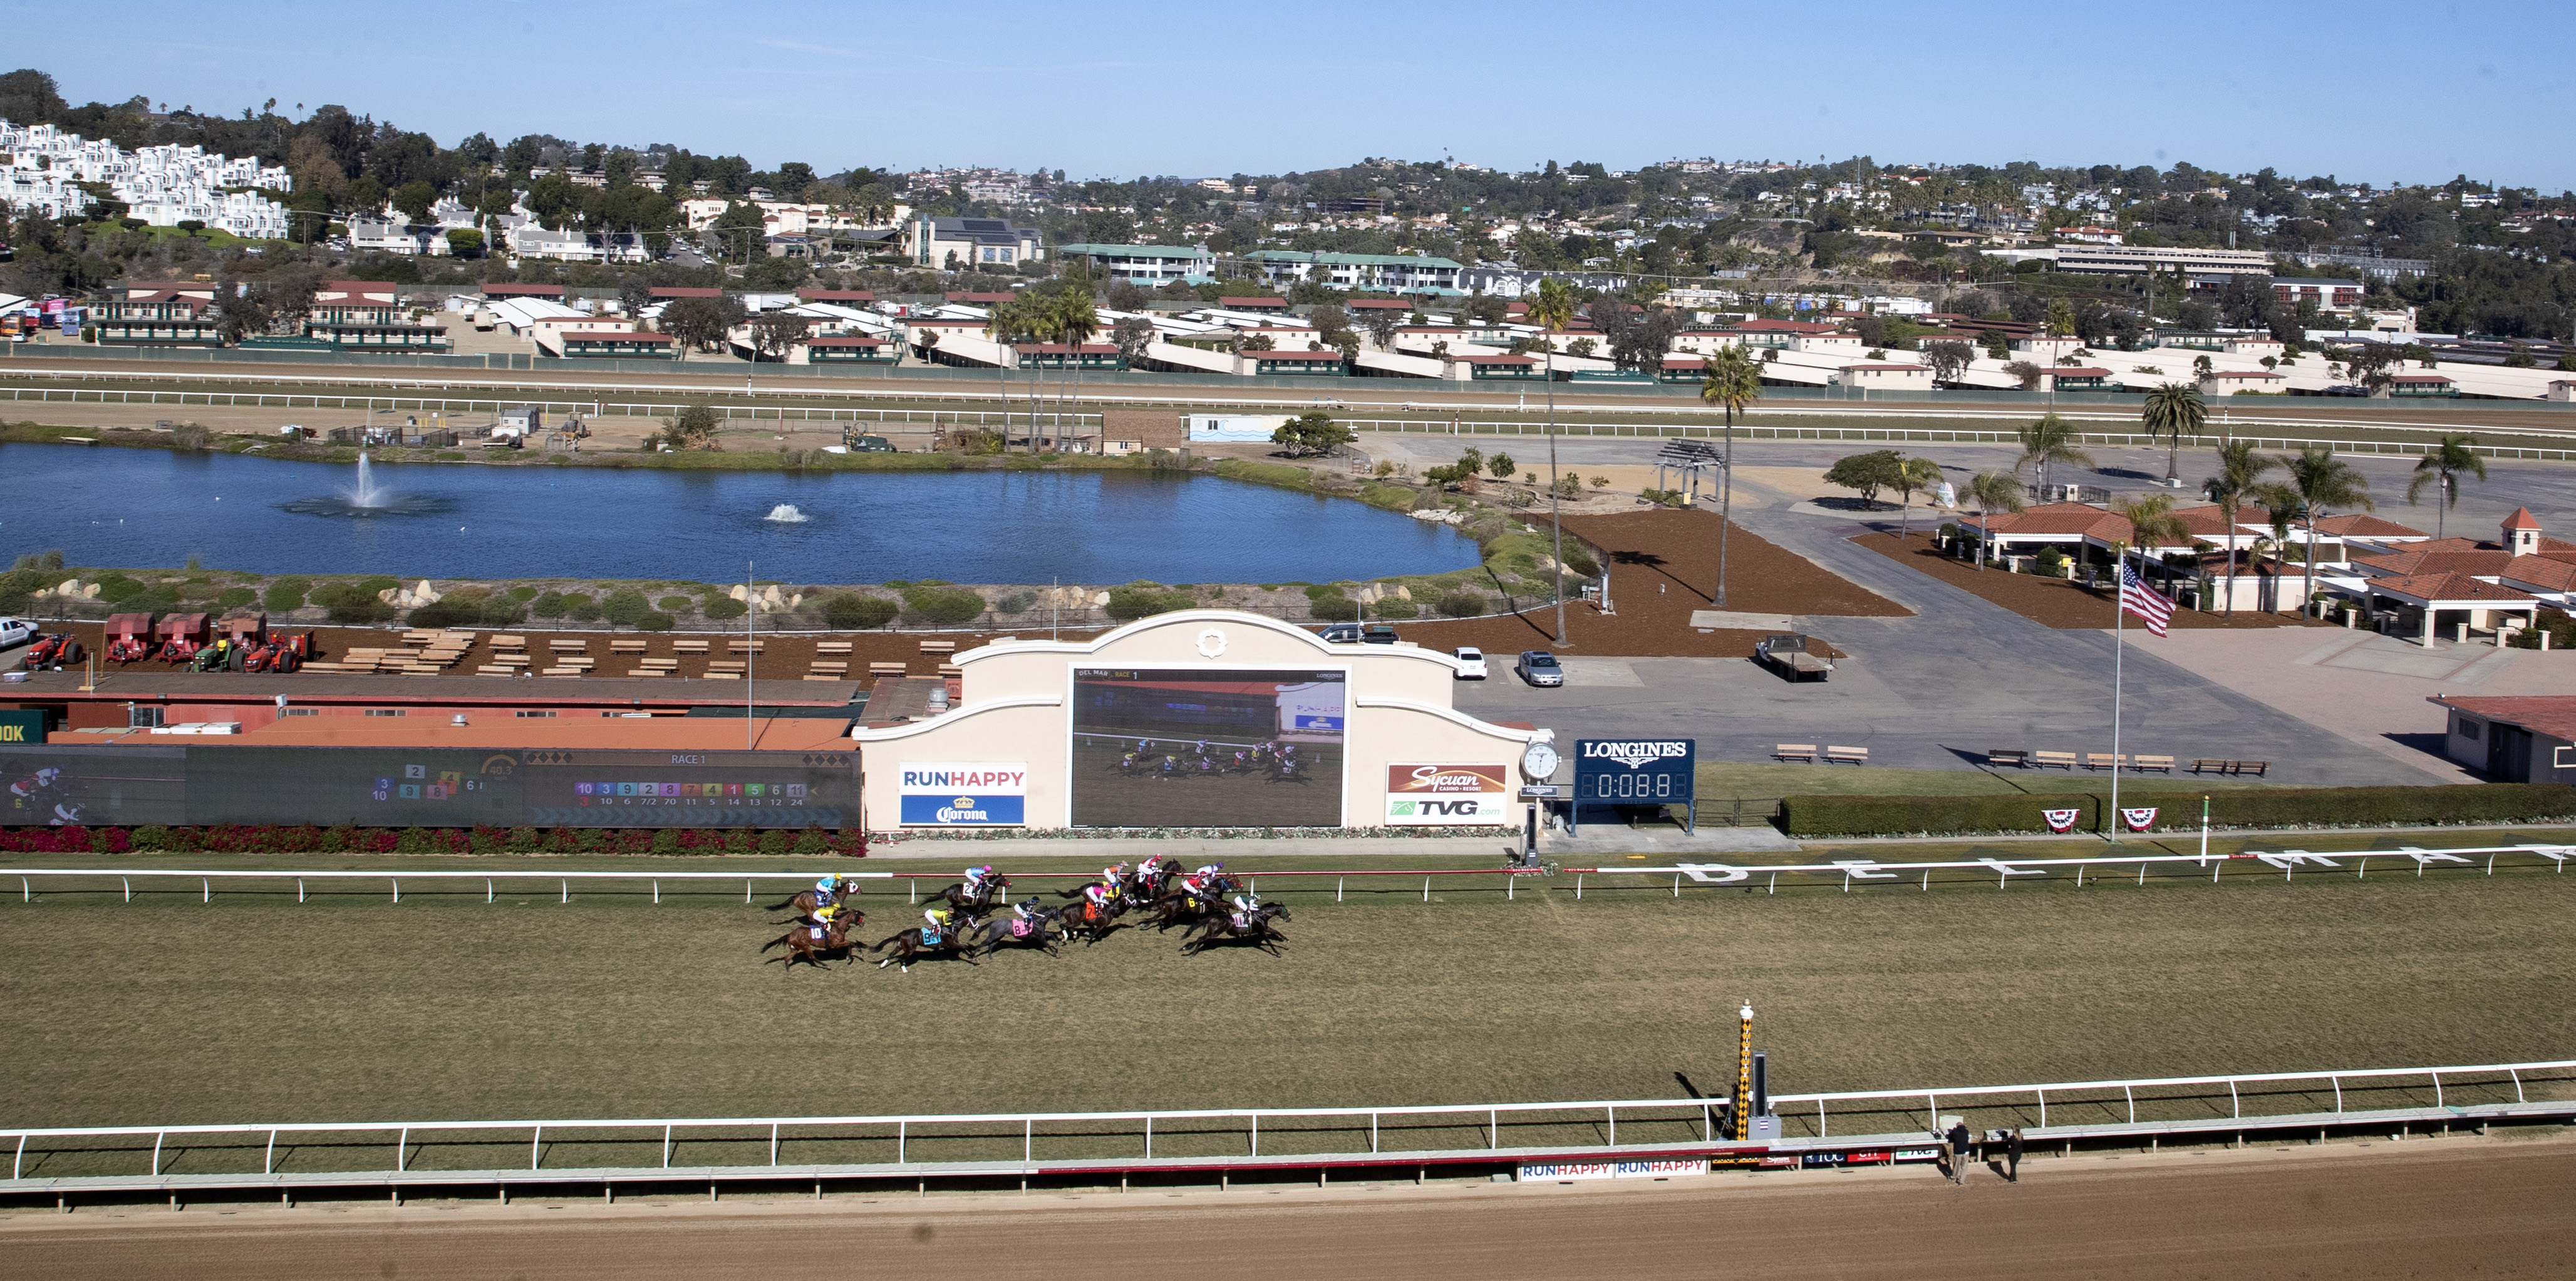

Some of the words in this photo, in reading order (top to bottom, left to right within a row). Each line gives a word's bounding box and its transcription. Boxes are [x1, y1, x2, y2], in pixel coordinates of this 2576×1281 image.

[1133, 672, 1137, 680] 1
[0, 725, 24, 741] OK
[1584, 742, 1686, 757] LONGINES
[671, 755, 698, 764] RACE
[700, 755, 705, 764] 1
[412, 767, 419, 777] 2
[381, 779, 388, 789] 3
[904, 772, 1024, 786] RUNHAPPY
[1411, 766, 1479, 792] Sycuan
[467, 781, 474, 790] 6
[578, 784, 592, 794] 10
[603, 784, 610, 794] 3
[624, 784, 631, 794] 9
[645, 784, 653, 794] 2
[666, 785, 674, 794] 8
[688, 785, 695, 794] 7
[708, 785, 716, 794] 4
[731, 786, 736, 794] 1
[752, 786, 758, 795] 5
[772, 786, 780, 795] 6
[791, 786, 802, 795] 11
[373, 791, 386, 801] 10
[406, 786, 413, 796] 9
[434, 787, 441, 797] 8
[936, 806, 987, 824] Corona
[965, 885, 970, 893] 2
[1188, 898, 1196, 908] 6
[1087, 908, 1093, 917] 7
[1235, 916, 1242, 926] 11
[811, 928, 822, 939] 10
[1015, 926, 1020, 935] 8
[924, 933, 930, 943] 9
[1817, 1151, 1844, 1162] TOC
[1523, 1163, 1609, 1177] RUNHAPPY
[1618, 1160, 1702, 1173] RUNHAPPY
